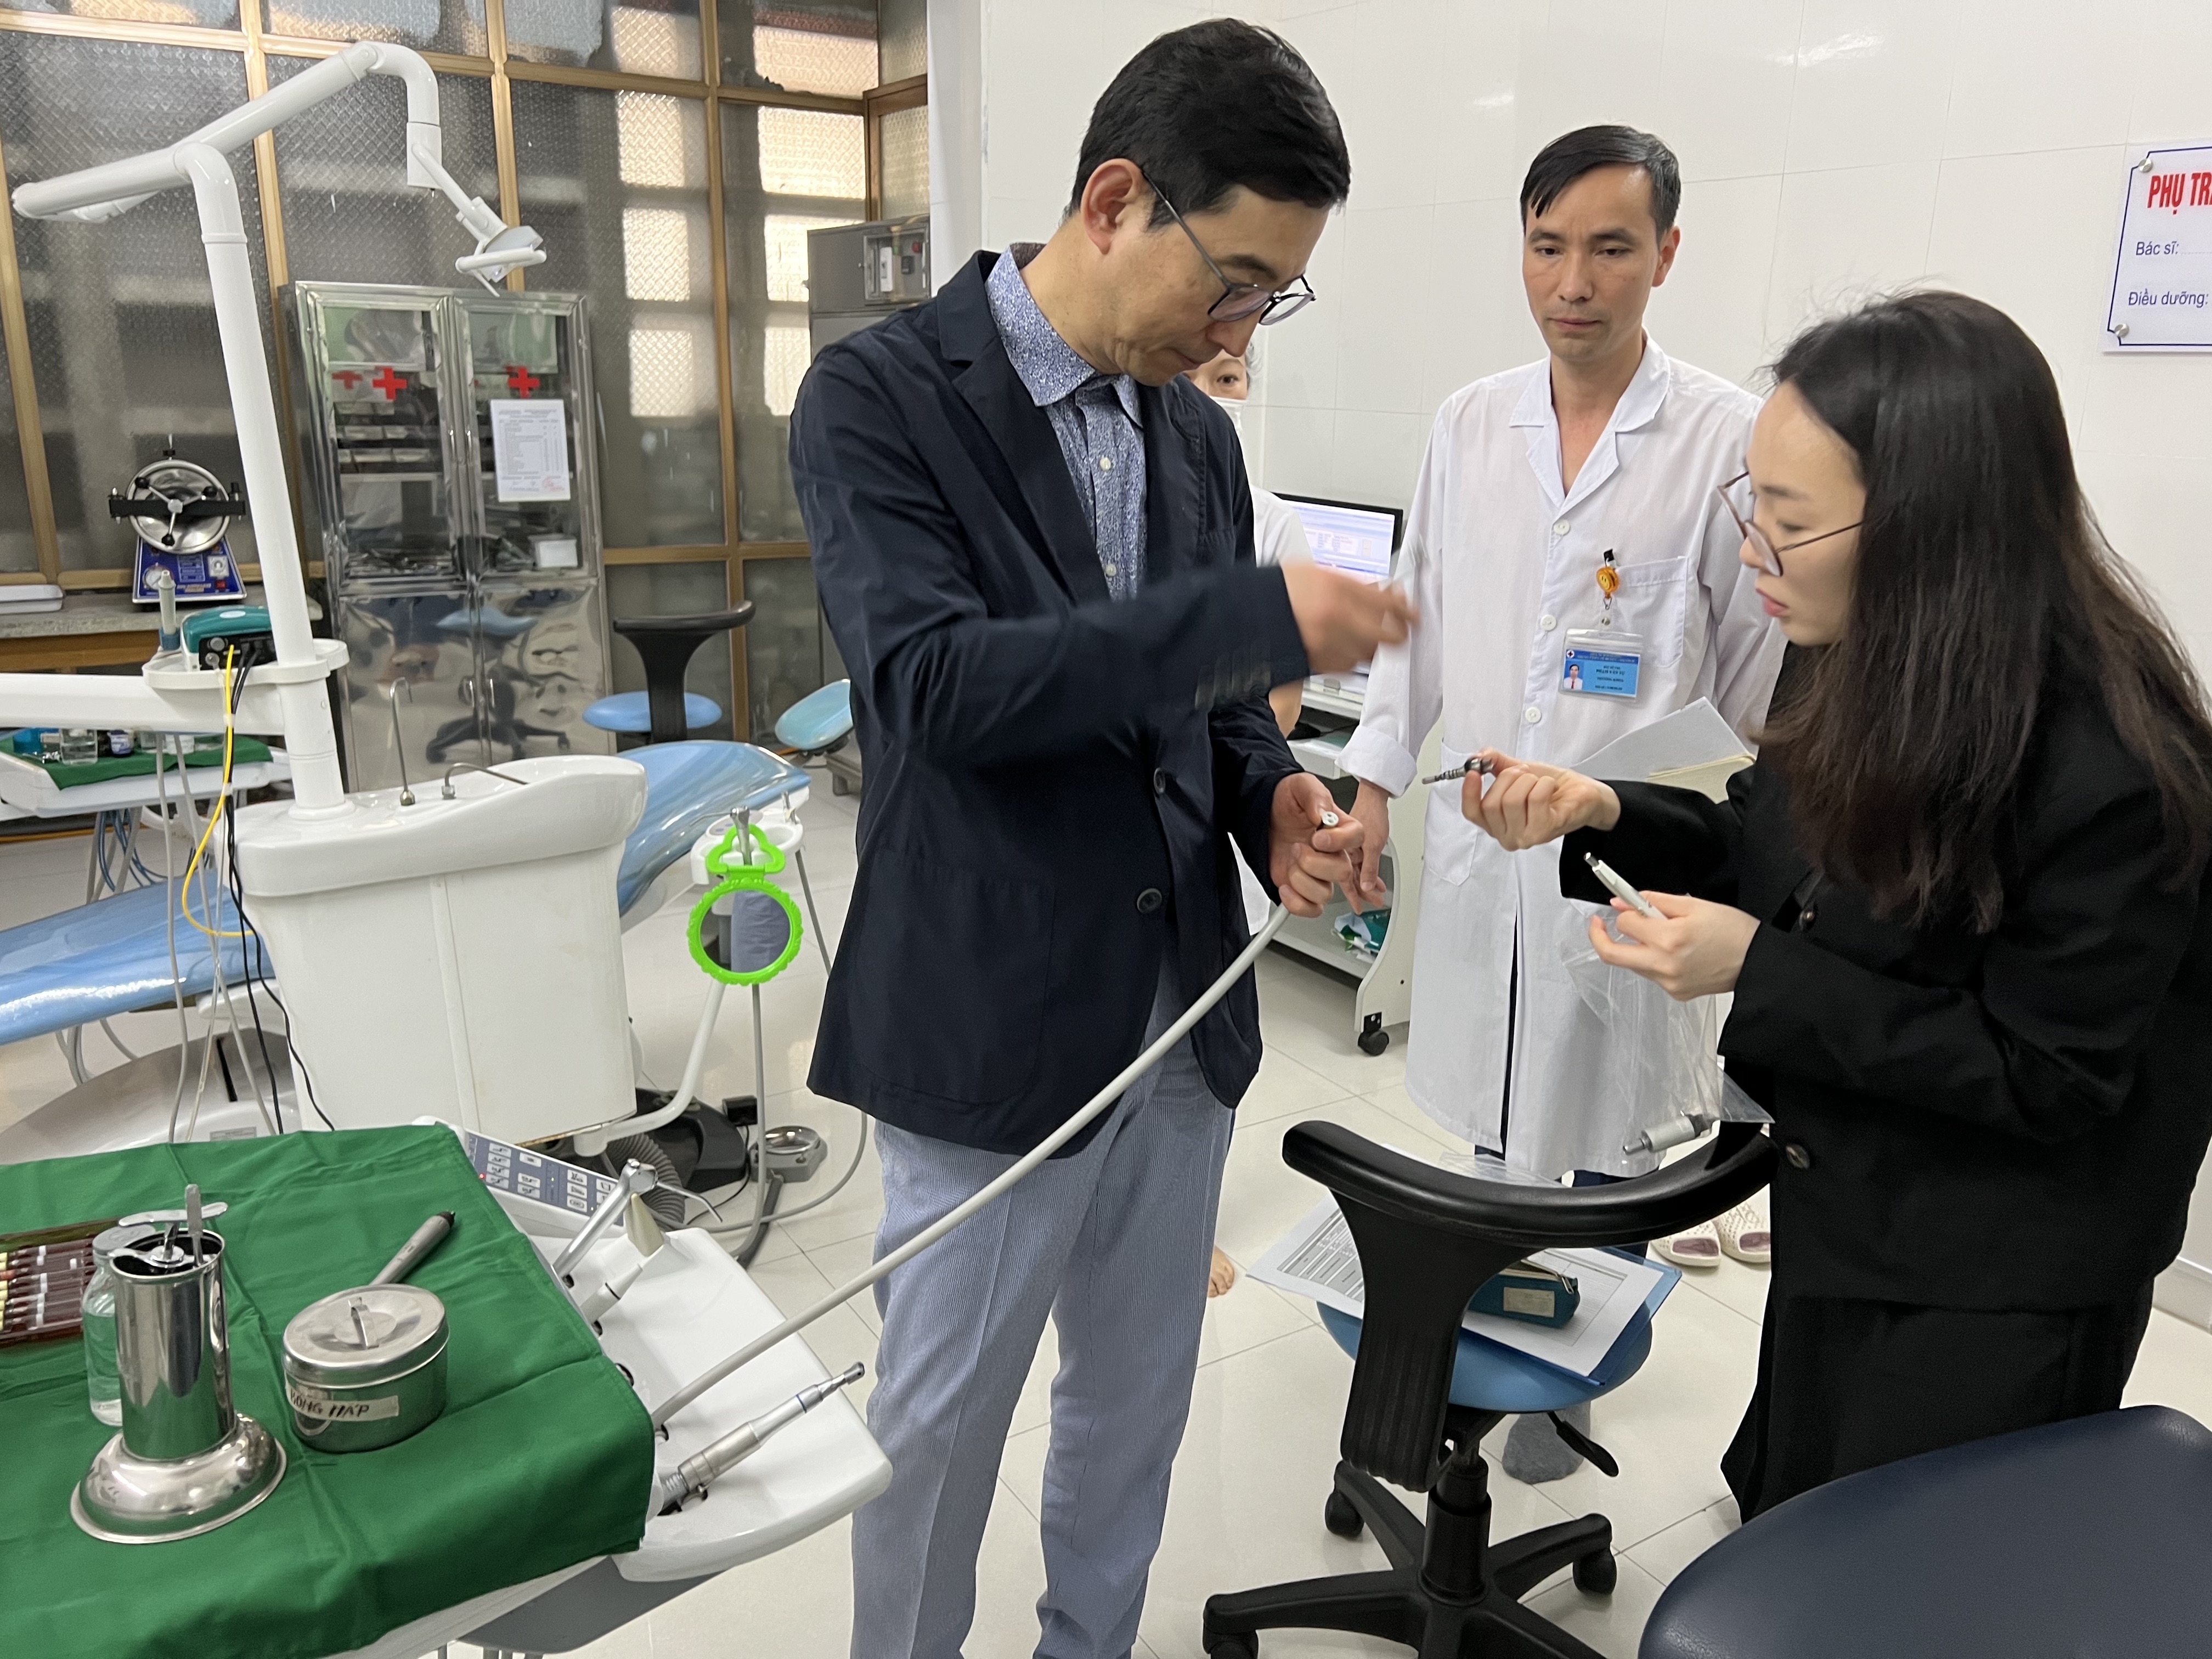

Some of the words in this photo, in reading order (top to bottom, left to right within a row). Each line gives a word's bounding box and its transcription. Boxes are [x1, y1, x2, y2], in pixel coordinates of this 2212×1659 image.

[2147, 173, 2186, 215] PHỤ
[2190, 172, 2212, 206] TR
[2136, 241, 2160, 255] Bác
[2164, 241, 2179, 255] sĩ:
[2129, 288, 2157, 306] Điều
[2161, 291, 2209, 308] dưỡng:
